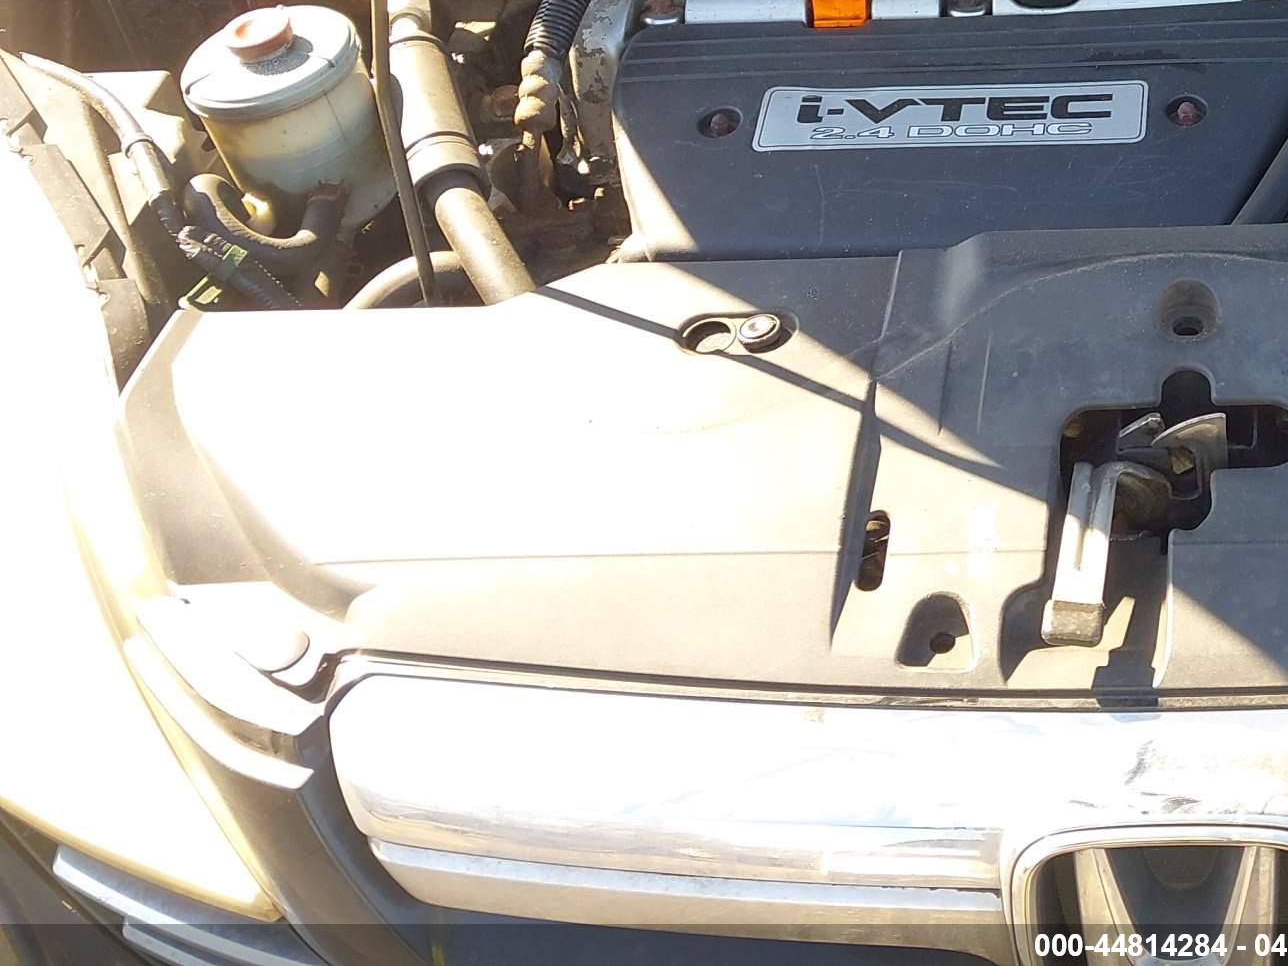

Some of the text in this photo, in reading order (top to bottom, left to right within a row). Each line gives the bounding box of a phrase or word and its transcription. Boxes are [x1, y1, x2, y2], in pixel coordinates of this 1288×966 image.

[796, 93, 1114, 125] i-VTEC
[810, 121, 1093, 140] 2.4 DOHC
